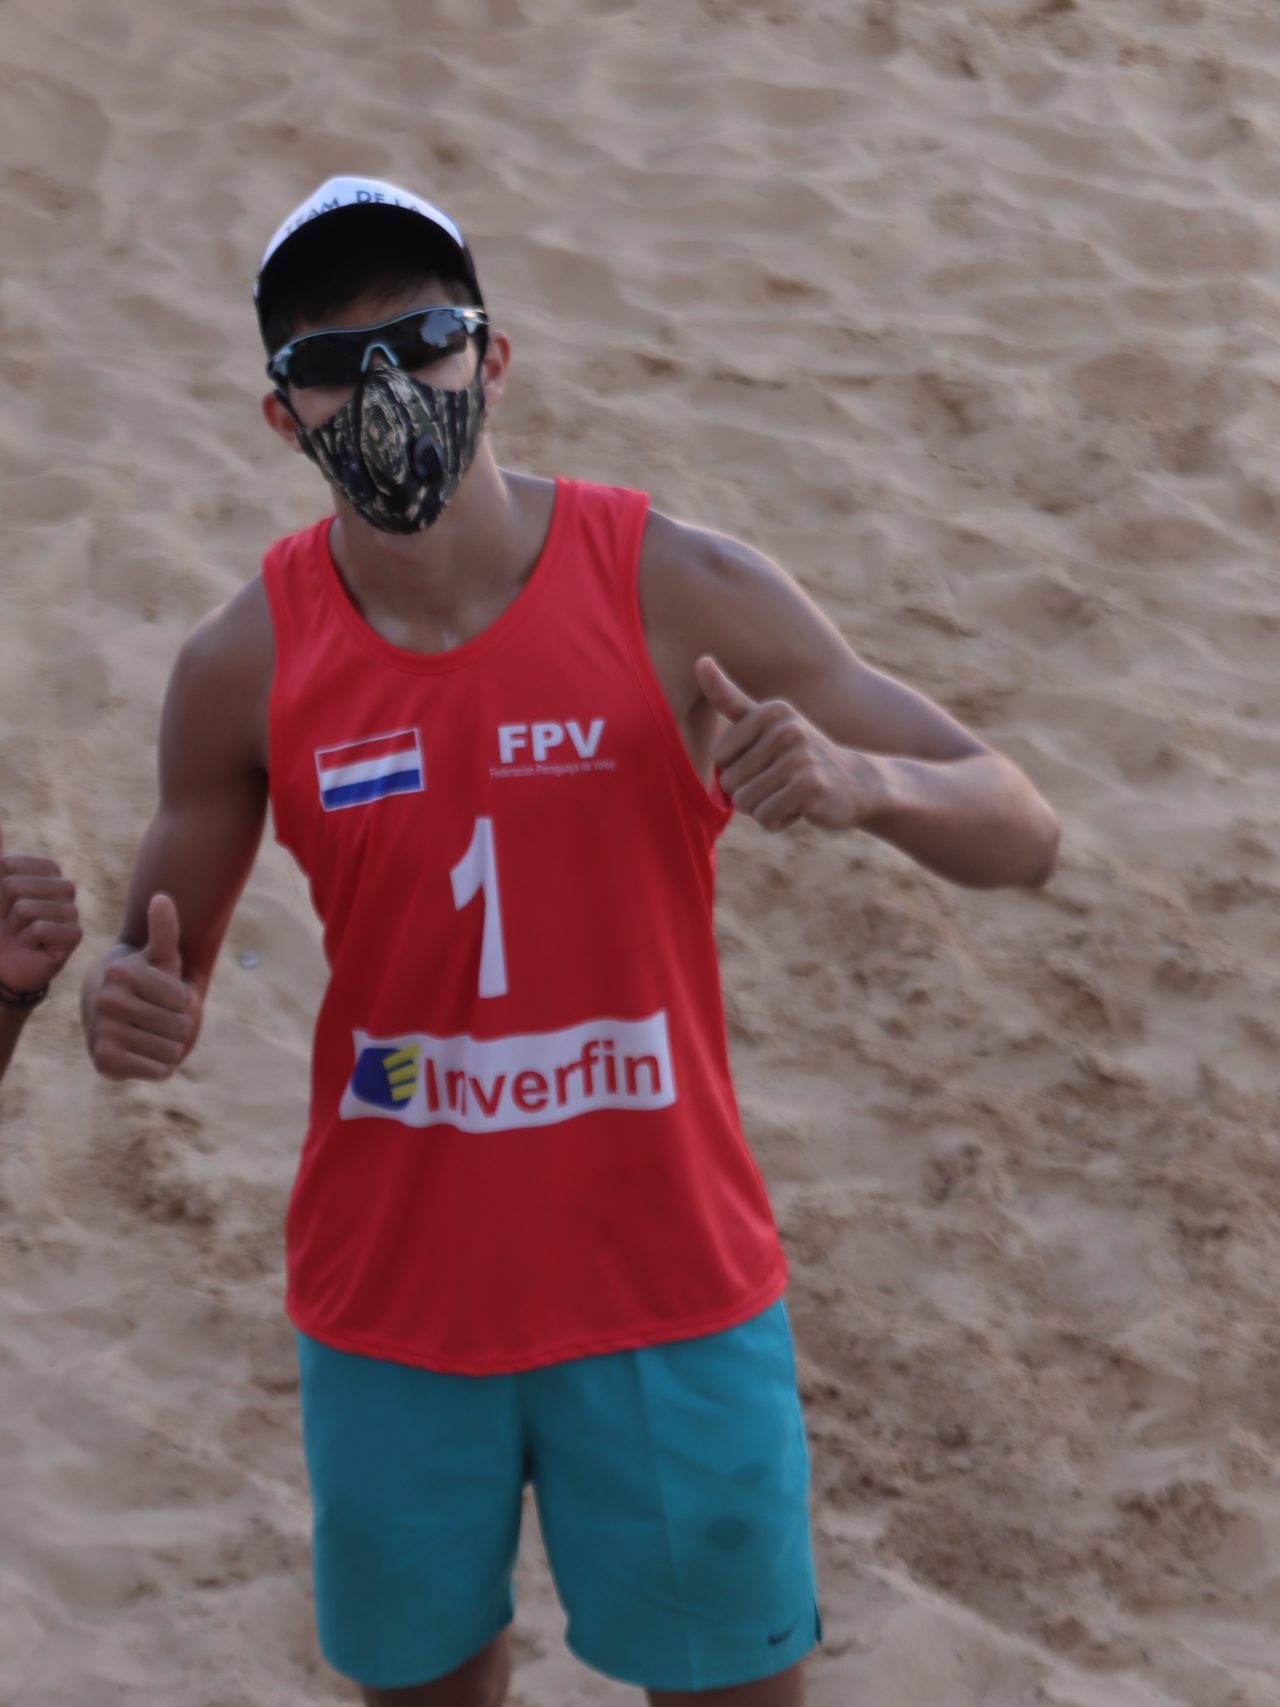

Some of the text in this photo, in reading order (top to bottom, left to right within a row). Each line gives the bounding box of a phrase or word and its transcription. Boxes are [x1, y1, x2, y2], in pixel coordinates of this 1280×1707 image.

[497, 717, 605, 764] FPV
[449, 814, 508, 999] 1
[425, 1040, 662, 1117] Inverfin
